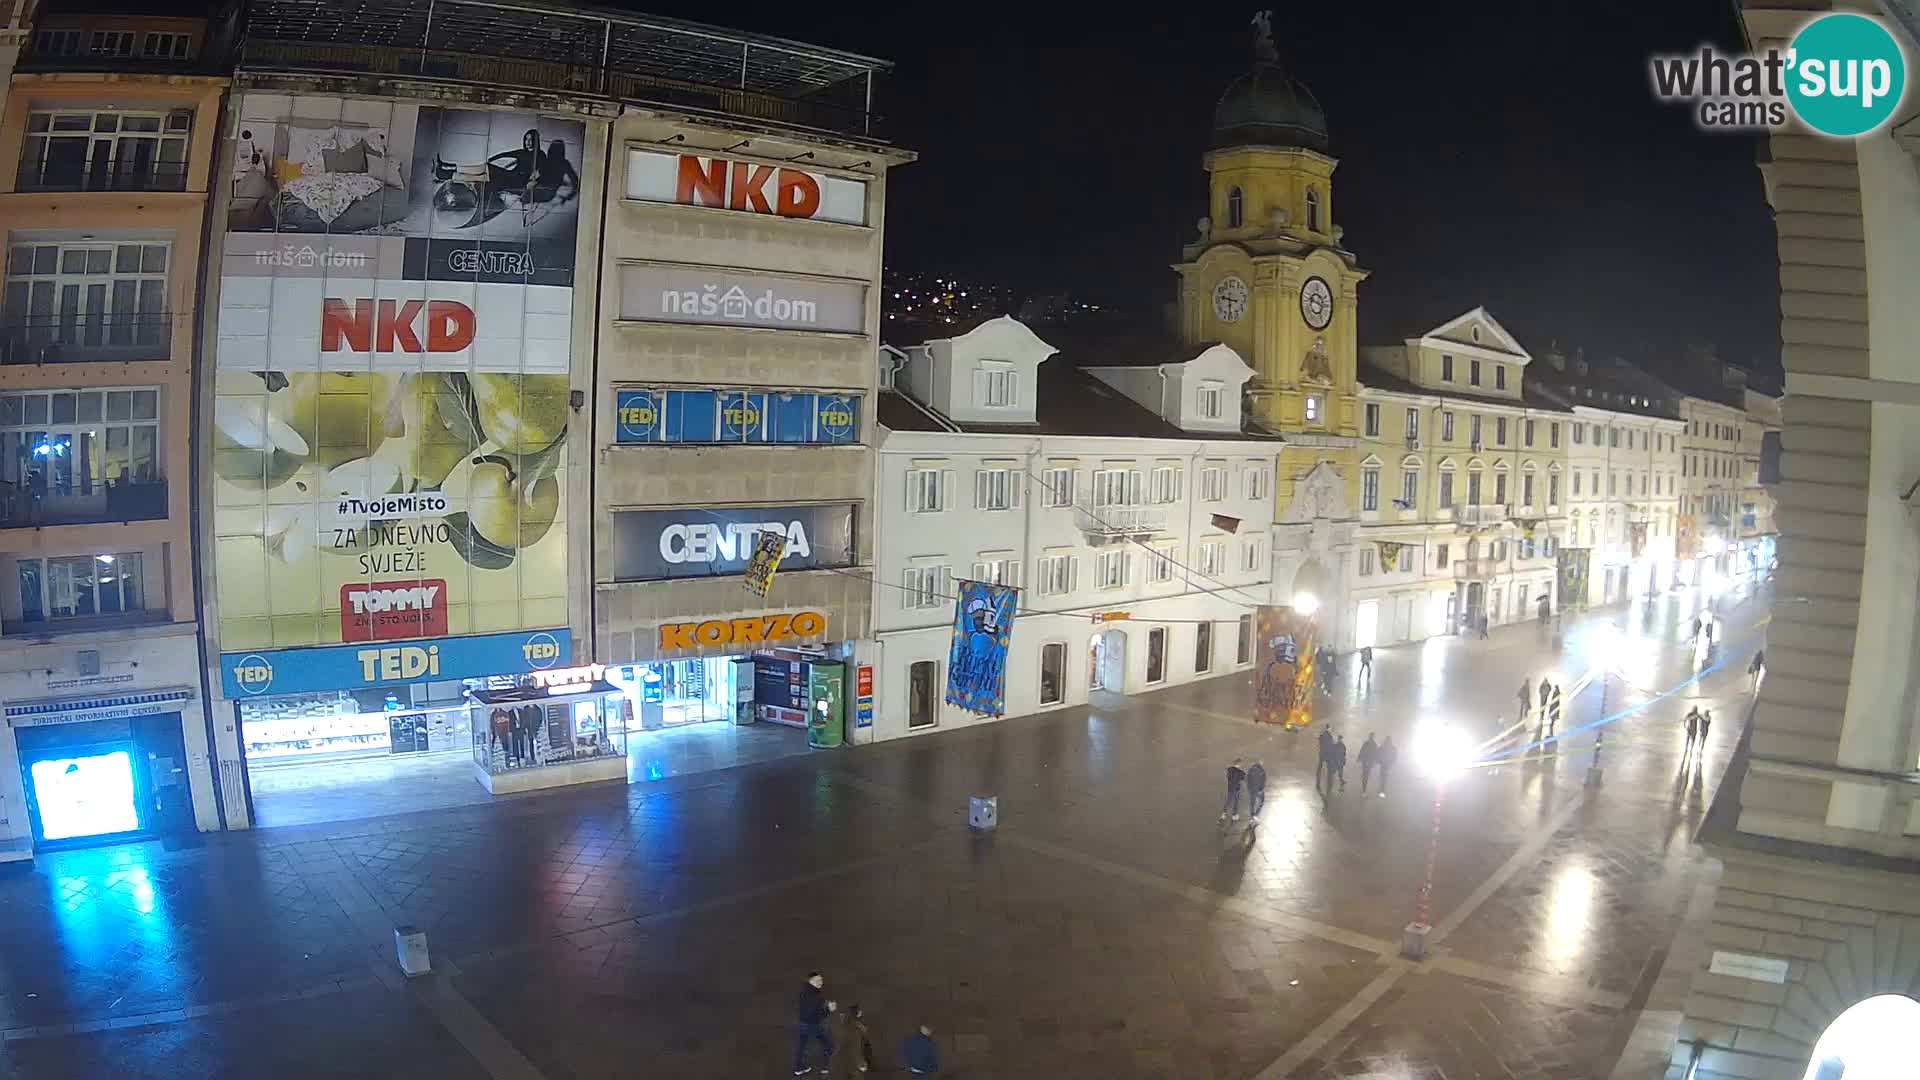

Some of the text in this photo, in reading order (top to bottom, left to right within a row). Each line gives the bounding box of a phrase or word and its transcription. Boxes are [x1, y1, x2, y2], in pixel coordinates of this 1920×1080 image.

[676, 154, 820, 219] NKD
[448, 249, 535, 275] CENTRA
[661, 283, 817, 323] naš dom
[320, 297, 477, 353] NKD
[619, 407, 658, 426] TEDi
[724, 408, 760, 426] TEDi
[820, 410, 853, 427] TEDi
[338, 496, 446, 515] #TvojeMisto
[334, 522, 451, 549] ZA DNEVNO
[359, 545, 427, 575] SVJEŽE
[348, 586, 439, 614] TOMMY
[660, 612, 826, 650] KORZO
[358, 644, 441, 682] TEDi
[522, 643, 560, 660] TEDi
[233, 665, 273, 684] TEDi
